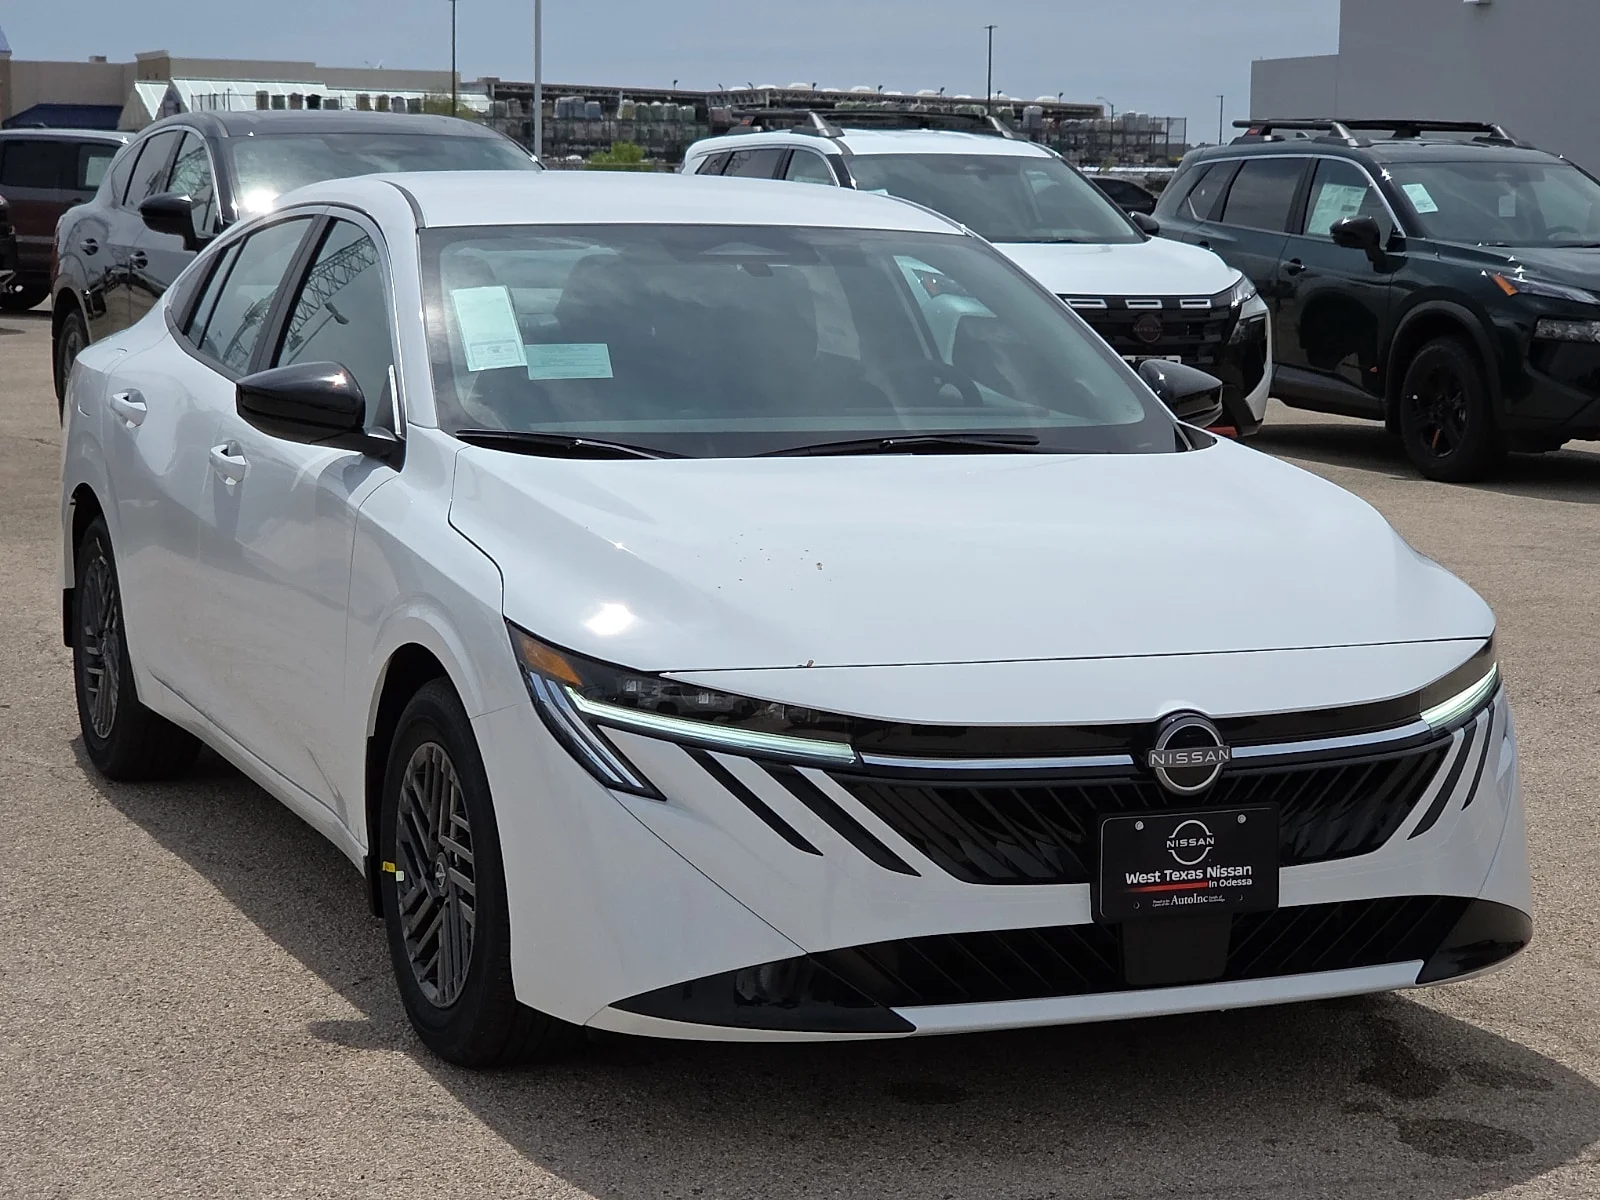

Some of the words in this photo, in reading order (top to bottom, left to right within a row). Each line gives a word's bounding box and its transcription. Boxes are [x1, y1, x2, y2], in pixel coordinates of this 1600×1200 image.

[1151, 748, 1230, 765] NISSAN
[1166, 837, 1215, 848] NISSAN
[1125, 871, 1161, 884] West
[1164, 868, 1204, 881] Texas
[1206, 865, 1252, 878] Nissan
[1219, 878, 1253, 887] Odessa
[1170, 893, 1209, 906] AutoInc
